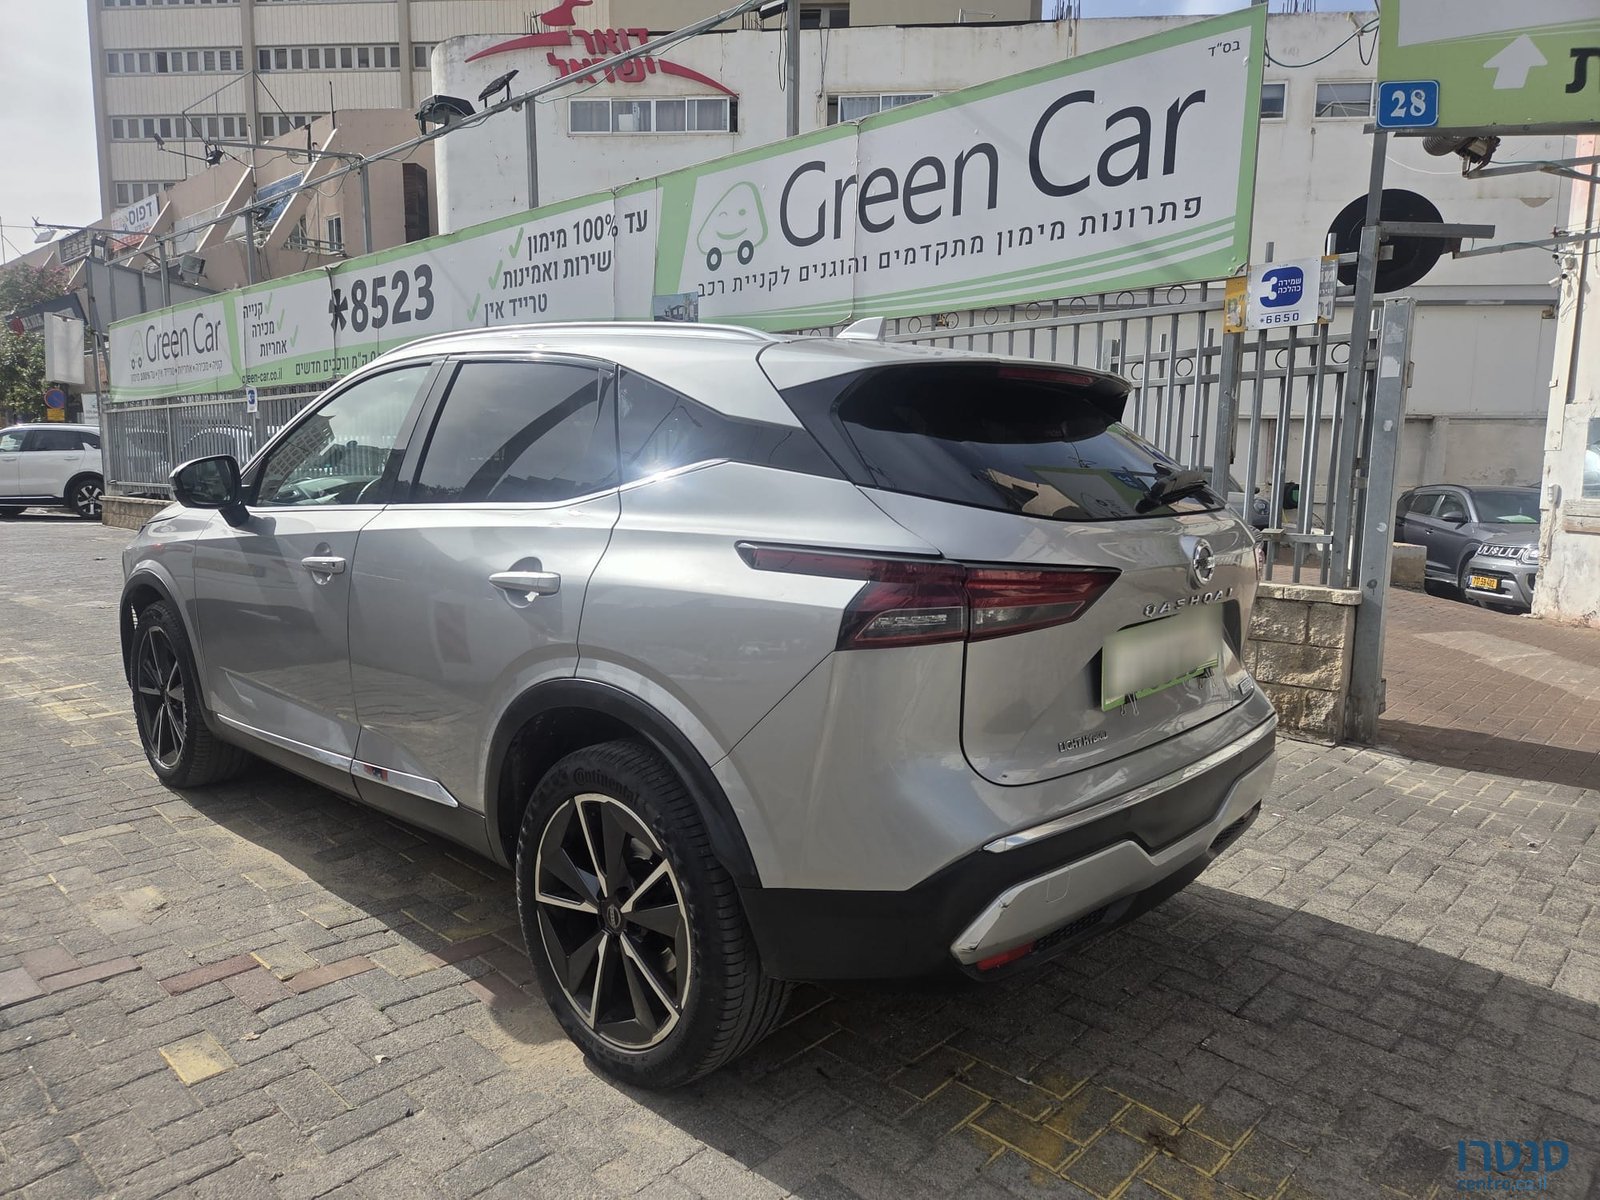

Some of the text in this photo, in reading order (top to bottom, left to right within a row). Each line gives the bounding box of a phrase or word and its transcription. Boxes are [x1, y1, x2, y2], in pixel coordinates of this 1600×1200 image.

[572, 28, 648, 55] דואר
[1208, 40, 1240, 57] בס"ד
[547, 52, 656, 83] ישראל
[1390, 89, 1426, 118] 28
[780, 89, 1206, 247] Green Car
[128, 202, 153, 226] דפוס
[527, 209, 648, 261] עד 100% מימון
[698, 196, 1202, 297] פתרונות מימון מתקדמים והוגנים לקניית רכב
[502, 250, 612, 290] שירות ואמינות
[1278, 277, 1302, 286] שמירה
[1277, 285, 1302, 294] כהלכה
[243, 302, 263, 320] קנייה
[484, 293, 548, 327] טרייד אין
[145, 312, 221, 362] Green Car
[251, 320, 275, 338] מכירה
[260, 339, 288, 358] אחריות
[295, 360, 321, 376] חדשים
